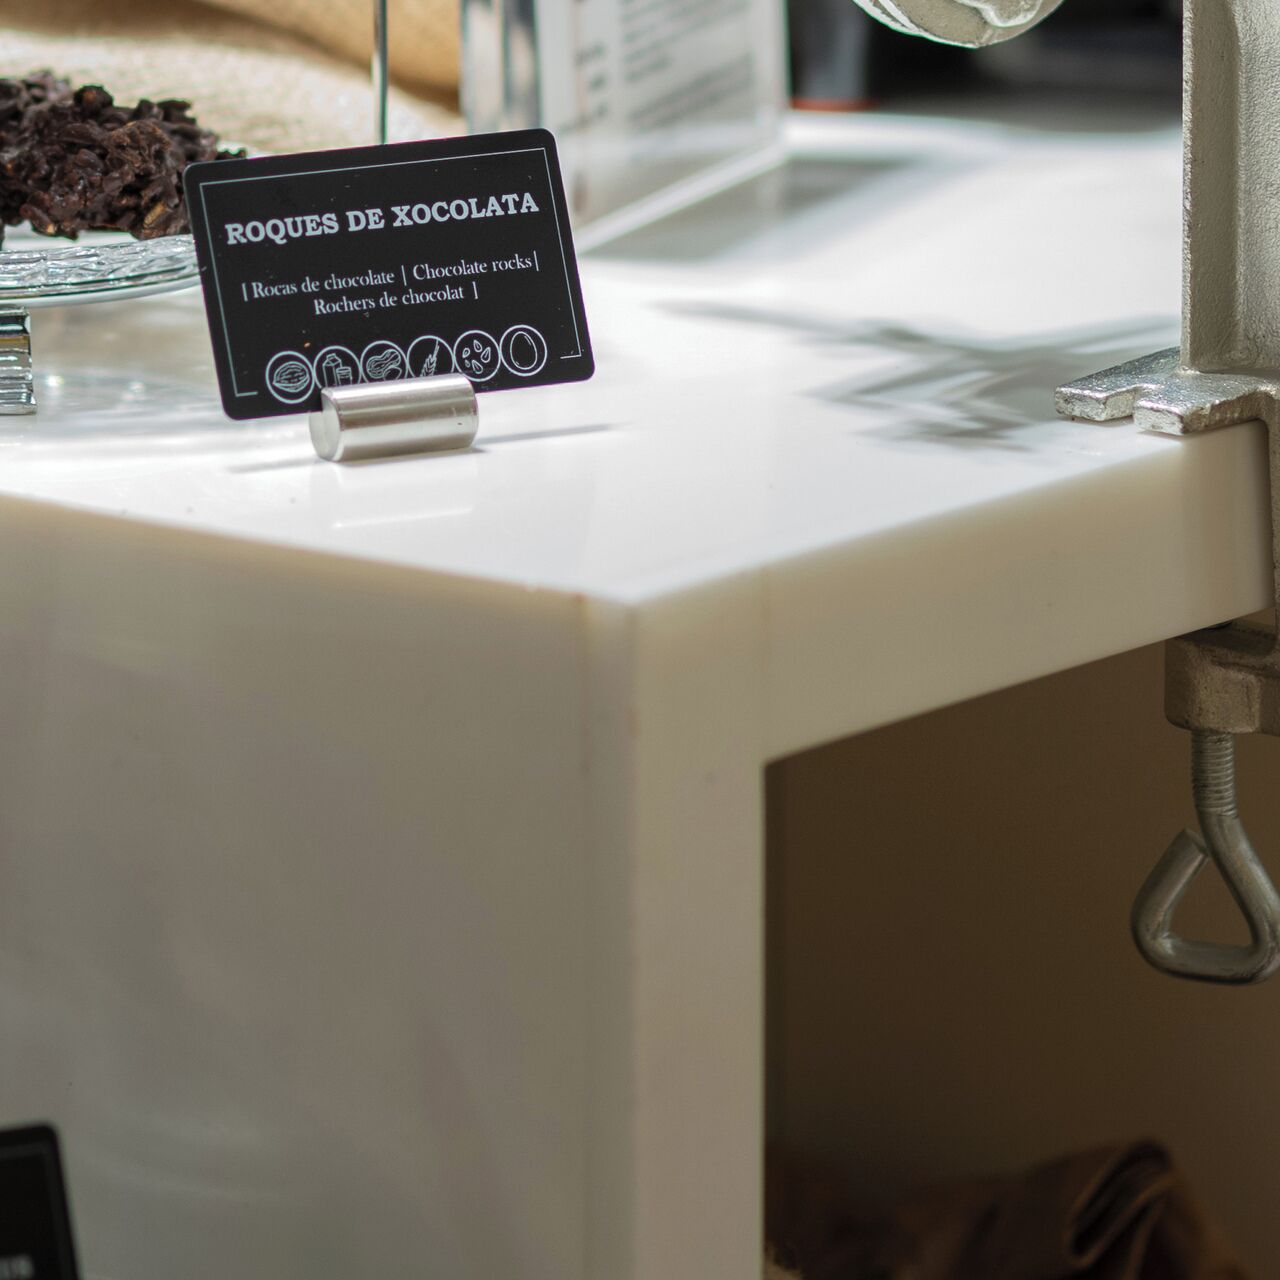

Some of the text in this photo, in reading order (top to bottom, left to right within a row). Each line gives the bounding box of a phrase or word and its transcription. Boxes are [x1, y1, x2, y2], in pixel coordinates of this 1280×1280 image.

[224, 192, 540, 246] ROQUES DE XOCOLATA
[251, 252, 532, 300] Rocas de chocolate Chocolate rocks
[313, 284, 465, 316] Rochers de chocolat
